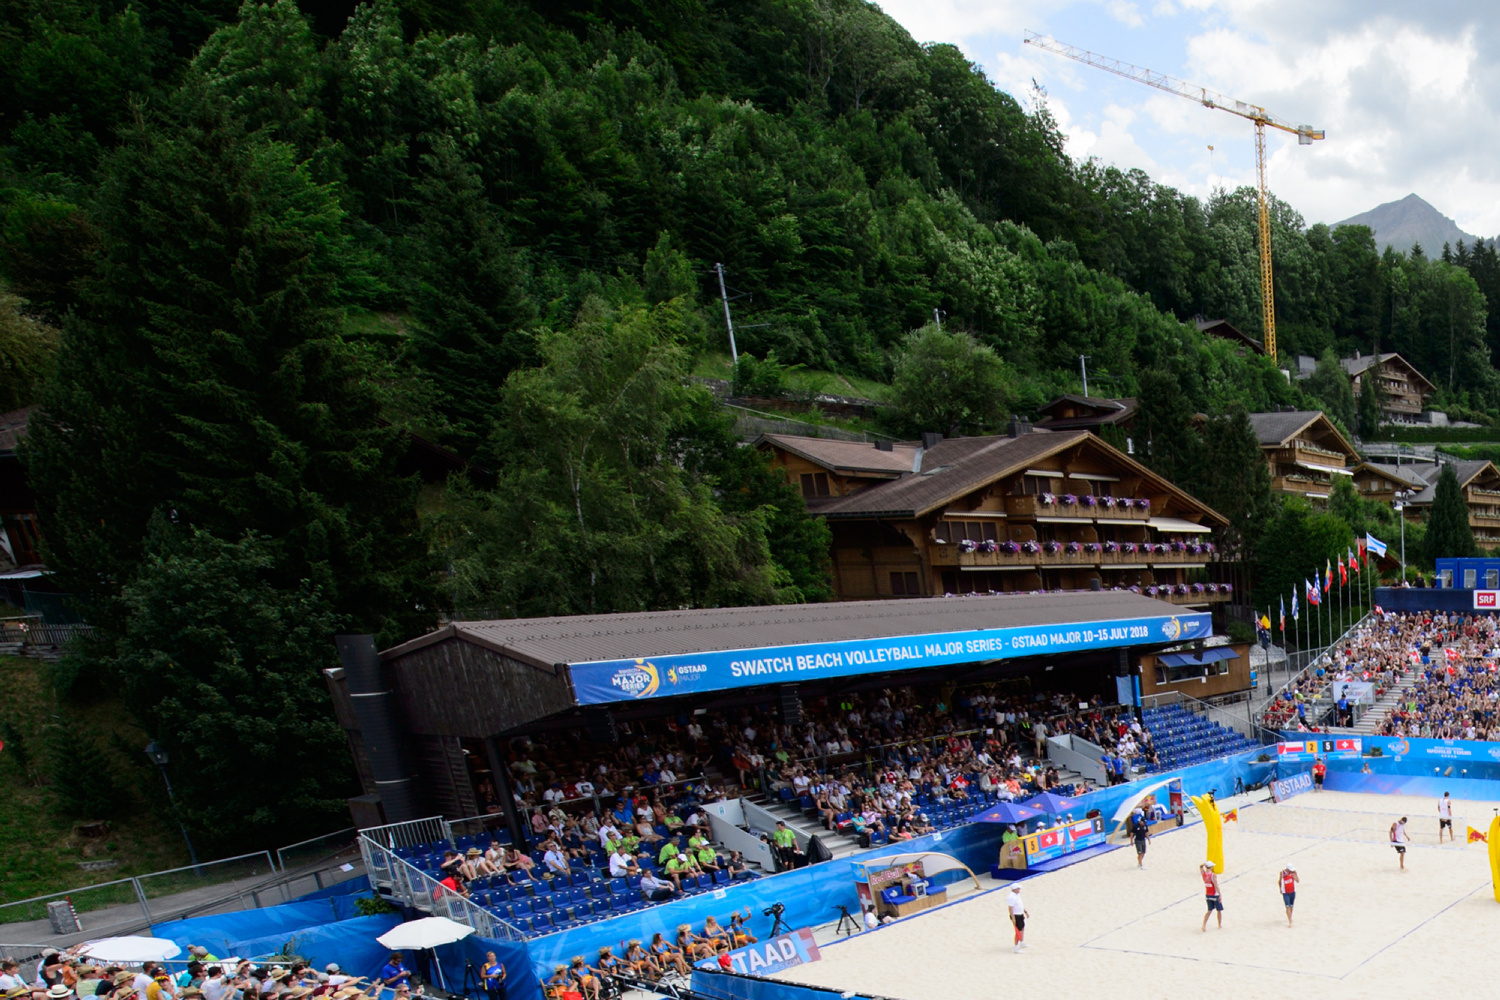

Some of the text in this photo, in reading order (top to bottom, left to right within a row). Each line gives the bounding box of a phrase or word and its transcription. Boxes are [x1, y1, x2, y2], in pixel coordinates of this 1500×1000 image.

[1478, 595, 1495, 604] SRF
[730, 657, 794, 677] SWATCH
[797, 652, 843, 671] BEACH
[844, 644, 923, 666] VOLLEYBALL
[924, 640, 964, 657] MAJOR
[965, 637, 1002, 654] SERIES
[1011, 633, 1048, 649] GSTAAD
[1050, 631, 1082, 646] MAJOR
[1109, 627, 1128, 640] JULY
[1129, 626, 1149, 638] 2018
[678, 664, 707, 674] GSTAAD
[611, 673, 651, 686] MAJOR
[1309, 743, 1314, 751] 2
[1325, 742, 1331, 751] 5
[1278, 777, 1312, 796] GSTAAD
[1096, 820, 1101, 831] 2
[1030, 841, 1036, 852] 5
[870, 874, 885, 886] Red
